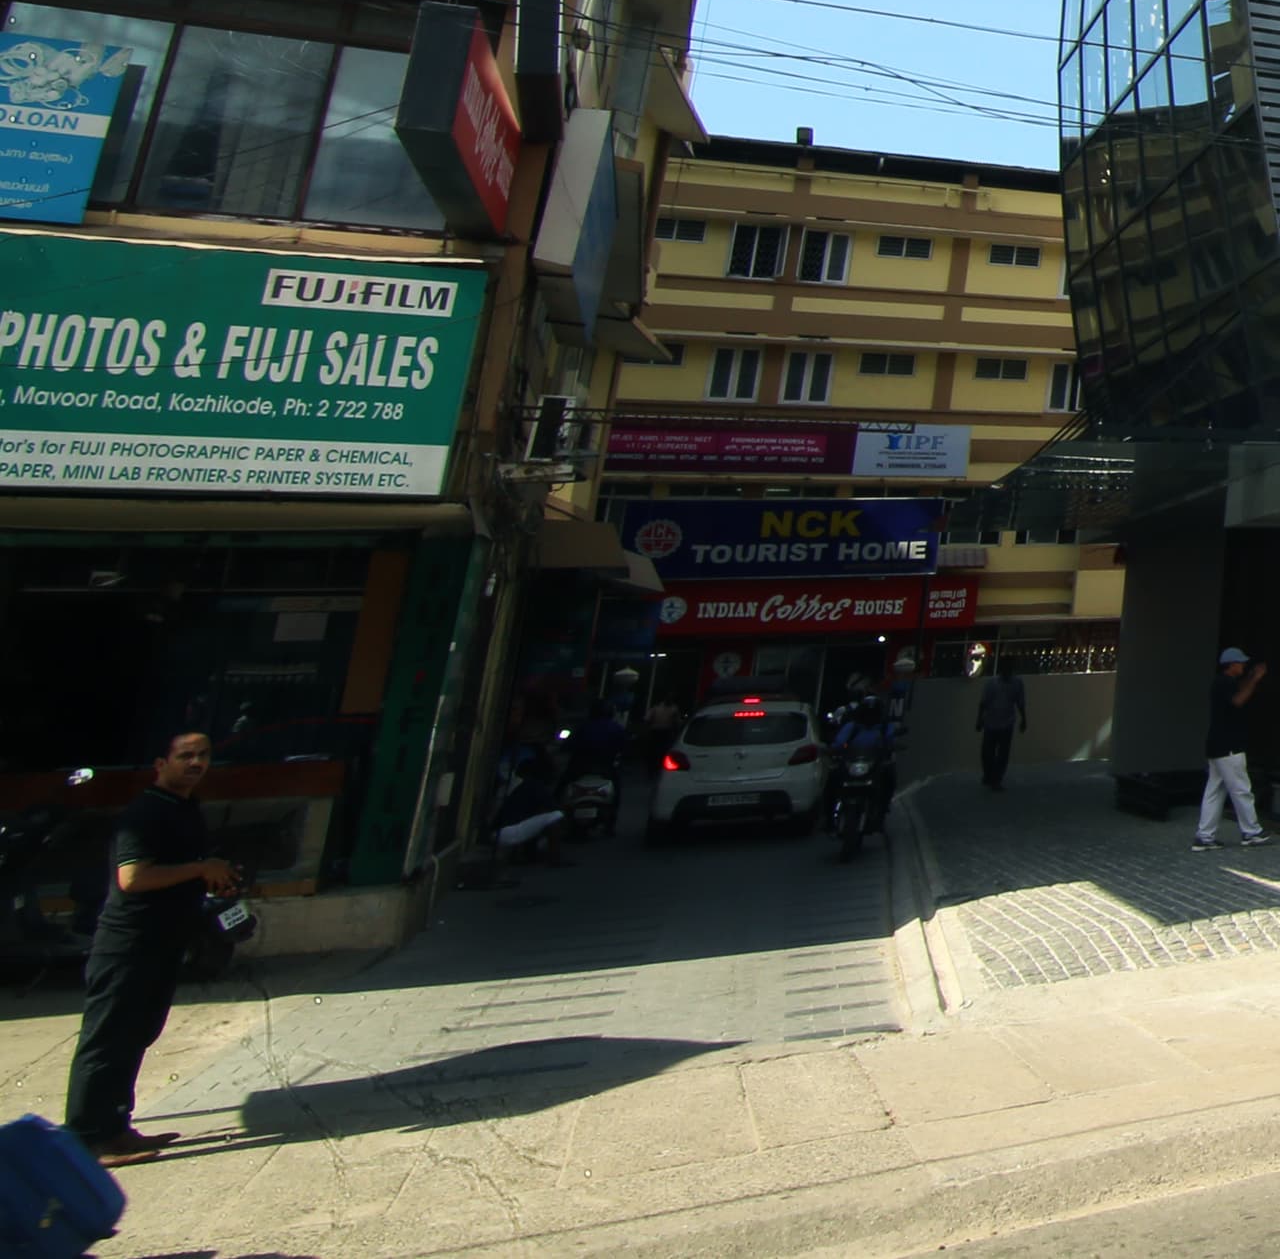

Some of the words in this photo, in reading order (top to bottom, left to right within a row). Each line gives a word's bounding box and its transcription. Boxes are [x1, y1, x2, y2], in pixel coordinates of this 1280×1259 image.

[15, 111, 79, 131] LOAN
[270, 274, 451, 312] FUJIFILM
[0, 310, 167, 377] PHOTOS
[173, 322, 207, 379] &
[216, 325, 314, 384] FUJI
[318, 330, 440, 391] SALES
[13, 385, 97, 408] Mavoor
[101, 390, 163, 412] Road,
[169, 393, 277, 419] Kozhikode,
[283, 398, 312, 417] Ph:
[316, 400, 329, 418] 2
[333, 401, 367, 420] 722
[371, 403, 405, 421] 788
[41, 440, 66, 456] for
[69, 441, 106, 457] FUJI
[109, 442, 251, 461] PHOTOGRAPHIC
[254, 447, 305, 463] PAPER
[308, 449, 321, 463] &
[325, 450, 413, 468] CHEMICAL,
[0, 462, 56, 481] PAPER,
[62, 465, 105, 481] MINI
[109, 467, 142, 482] LAB
[146, 468, 242, 485] FRONTIER-S
[246, 470, 310, 485] PRINTER
[315, 472, 374, 487] SYSTEM
[377, 474, 410, 488] ETC.
[760, 509, 864, 539] NCK
[690, 543, 829, 564] TOURIST
[838, 540, 928, 561] HOME
[697, 601, 758, 620] INDIAN
[853, 598, 905, 616] HOUSE
